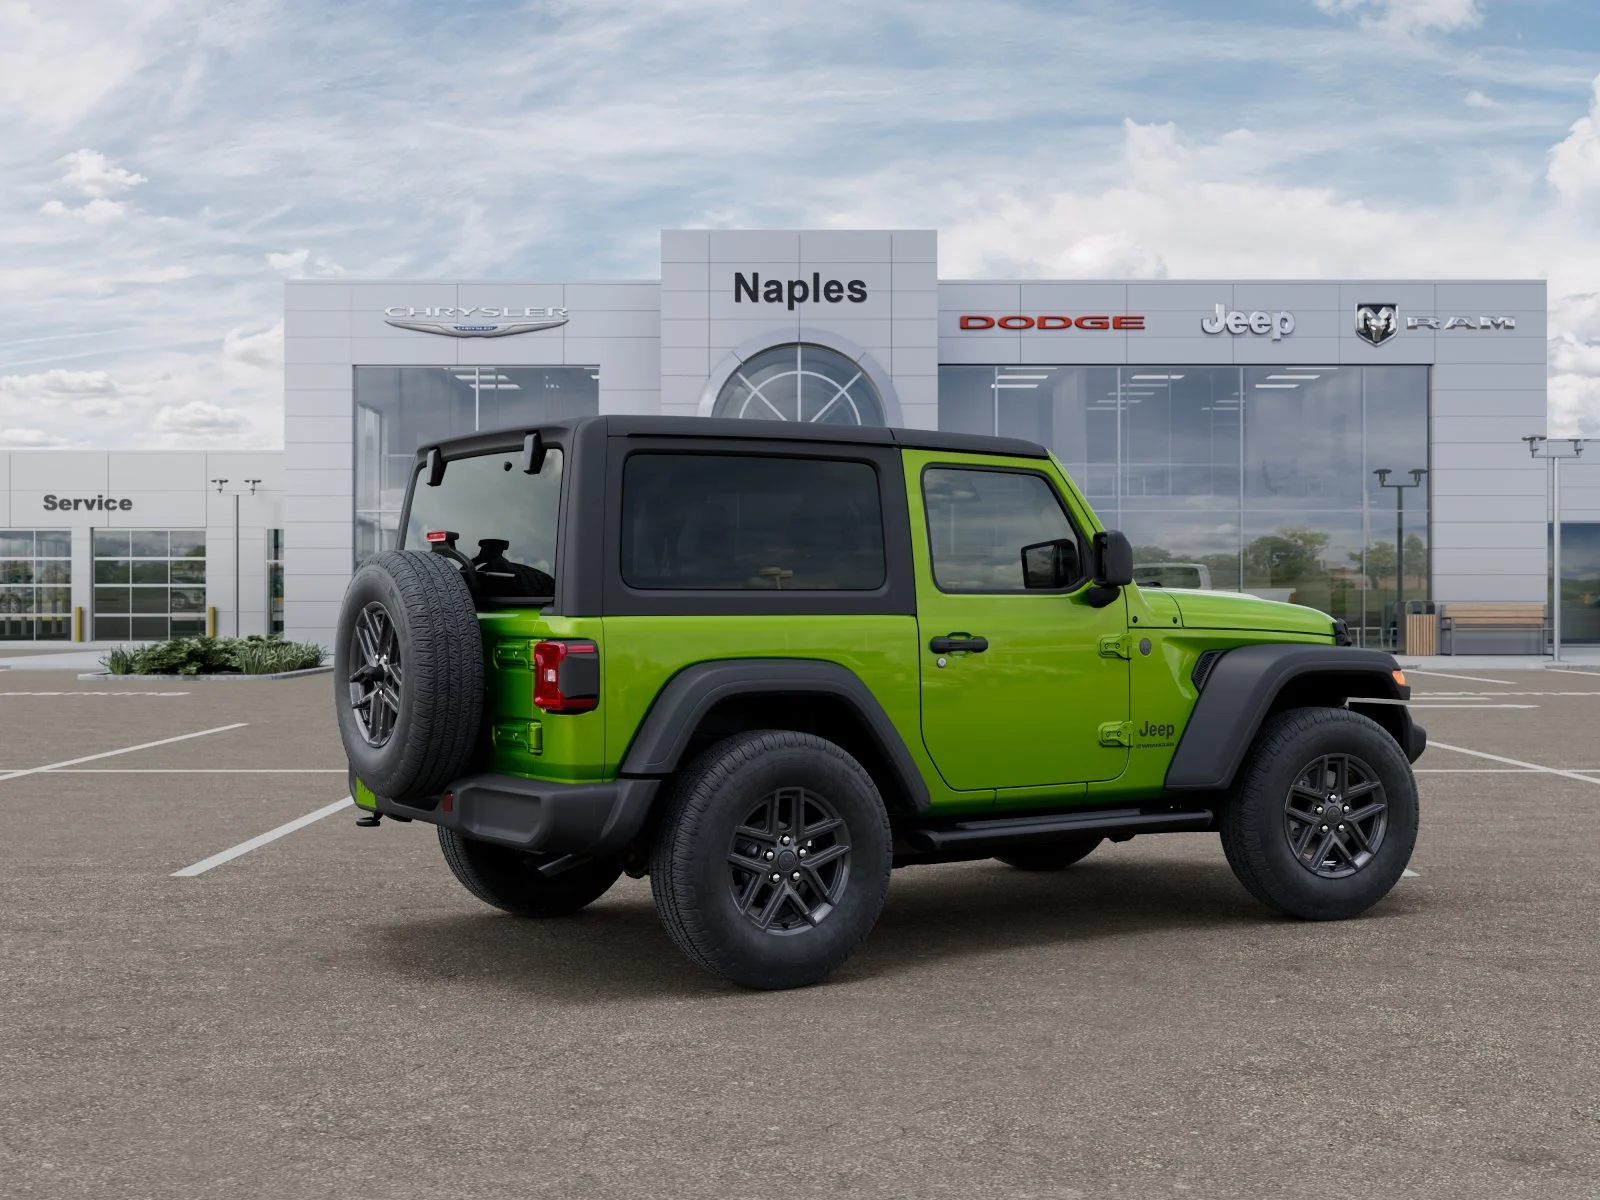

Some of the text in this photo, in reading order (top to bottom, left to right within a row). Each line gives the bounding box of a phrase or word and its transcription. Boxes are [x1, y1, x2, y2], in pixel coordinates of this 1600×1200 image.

[734, 272, 868, 311] Naples
[384, 306, 569, 318] CHRYSLER
[959, 315, 1146, 330] DODGE
[1201, 303, 1296, 342] Jeep
[1406, 316, 1516, 330] RAM
[43, 494, 133, 511] Service
[1139, 720, 1175, 740] Jeep
